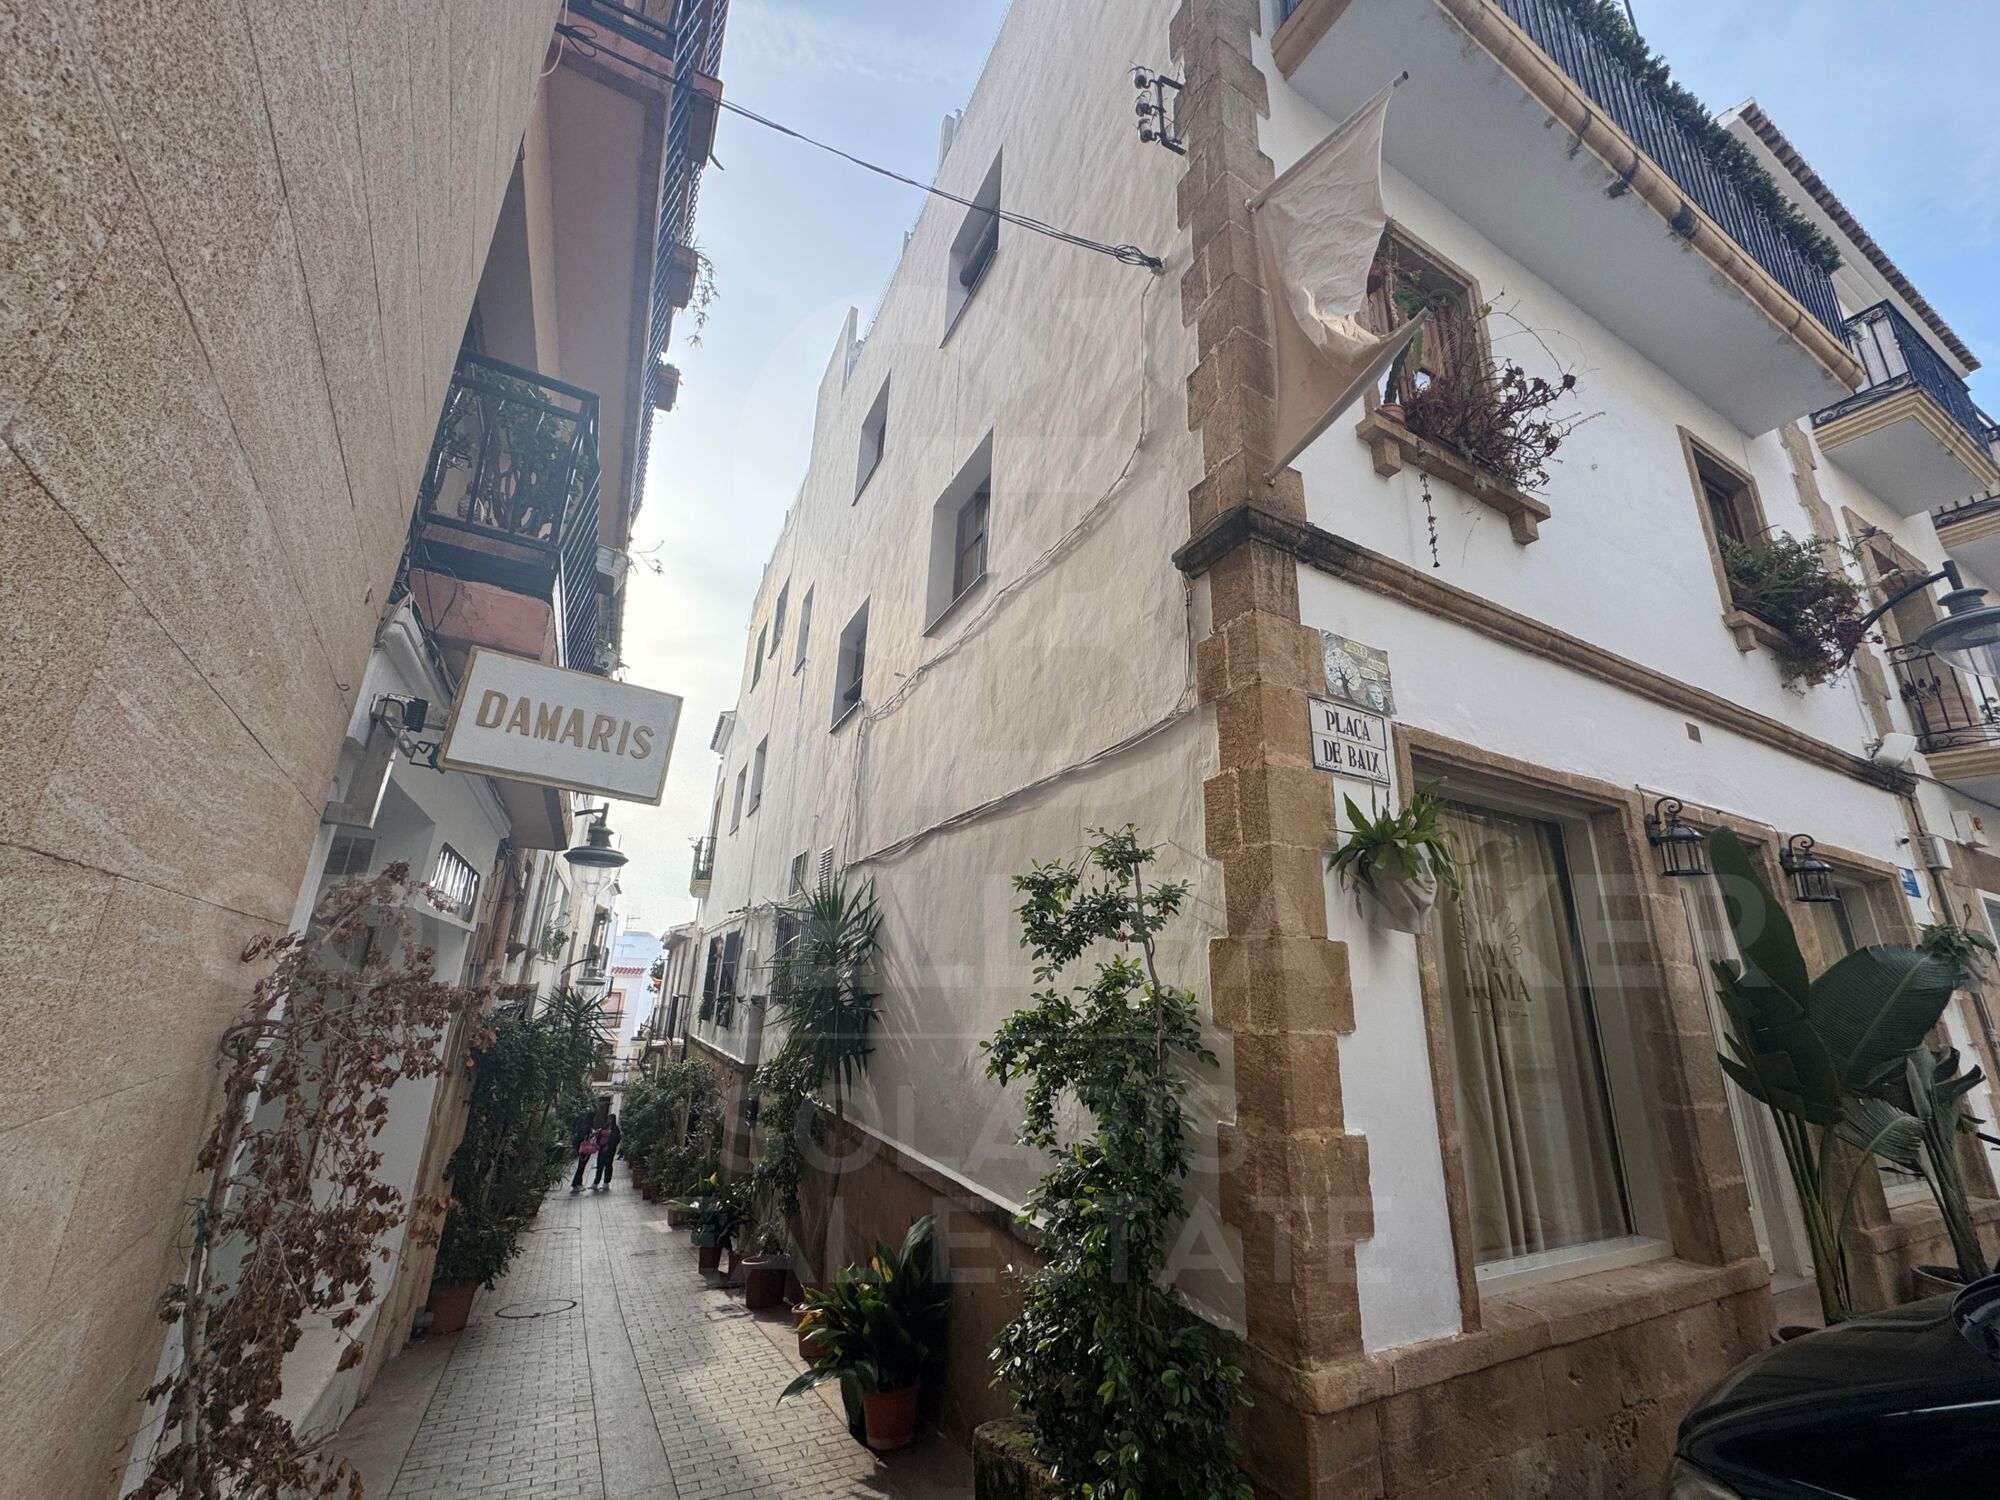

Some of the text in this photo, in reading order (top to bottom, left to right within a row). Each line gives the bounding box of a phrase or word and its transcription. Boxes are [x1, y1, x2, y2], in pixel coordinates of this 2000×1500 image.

[475, 689, 655, 760] DAMARIS
[1324, 709, 1371, 742] PLAÇA
[1322, 739, 1381, 774] DE BAIX
